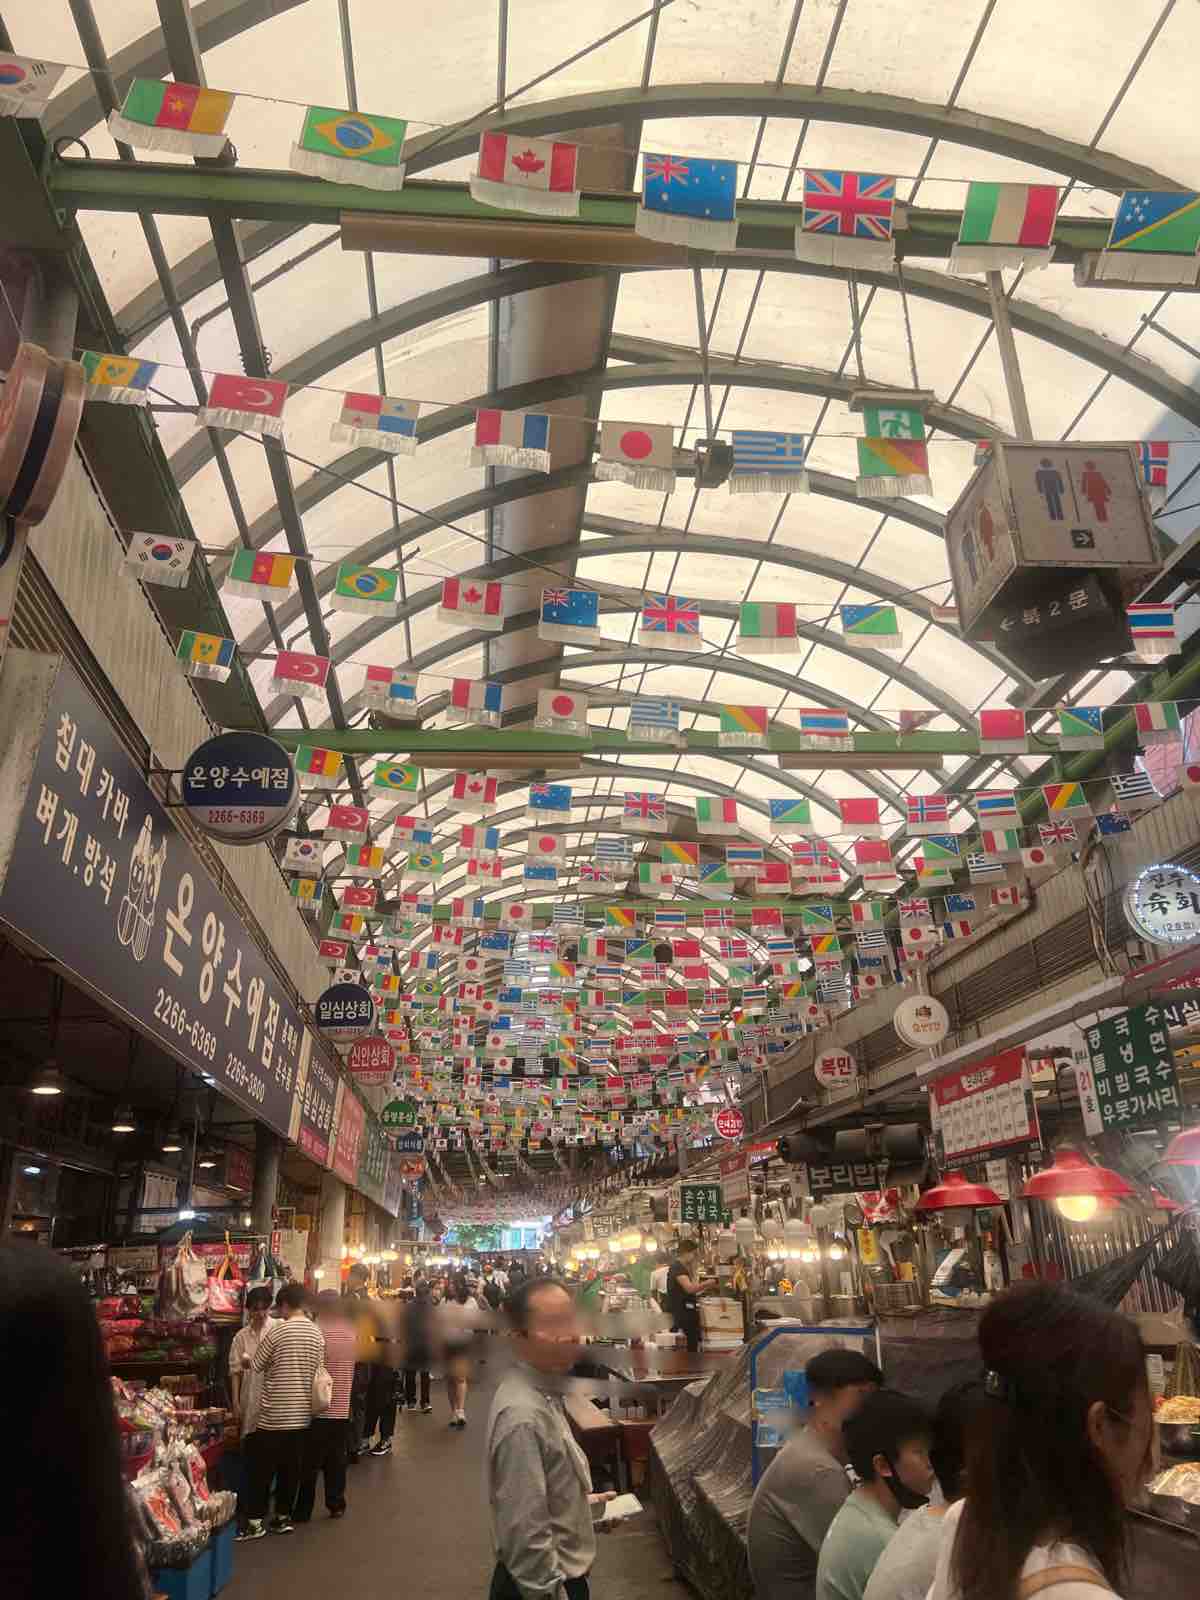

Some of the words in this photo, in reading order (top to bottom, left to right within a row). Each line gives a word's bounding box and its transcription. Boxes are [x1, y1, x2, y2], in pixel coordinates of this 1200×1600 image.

[188, 766, 288, 789] 온양수예점
[208, 810, 265, 824] 2266-6369
[164, 873, 280, 1069] 온양수예점
[320, 1000, 371, 1019] 일심상회
[154, 988, 216, 1060] 2266-6369
